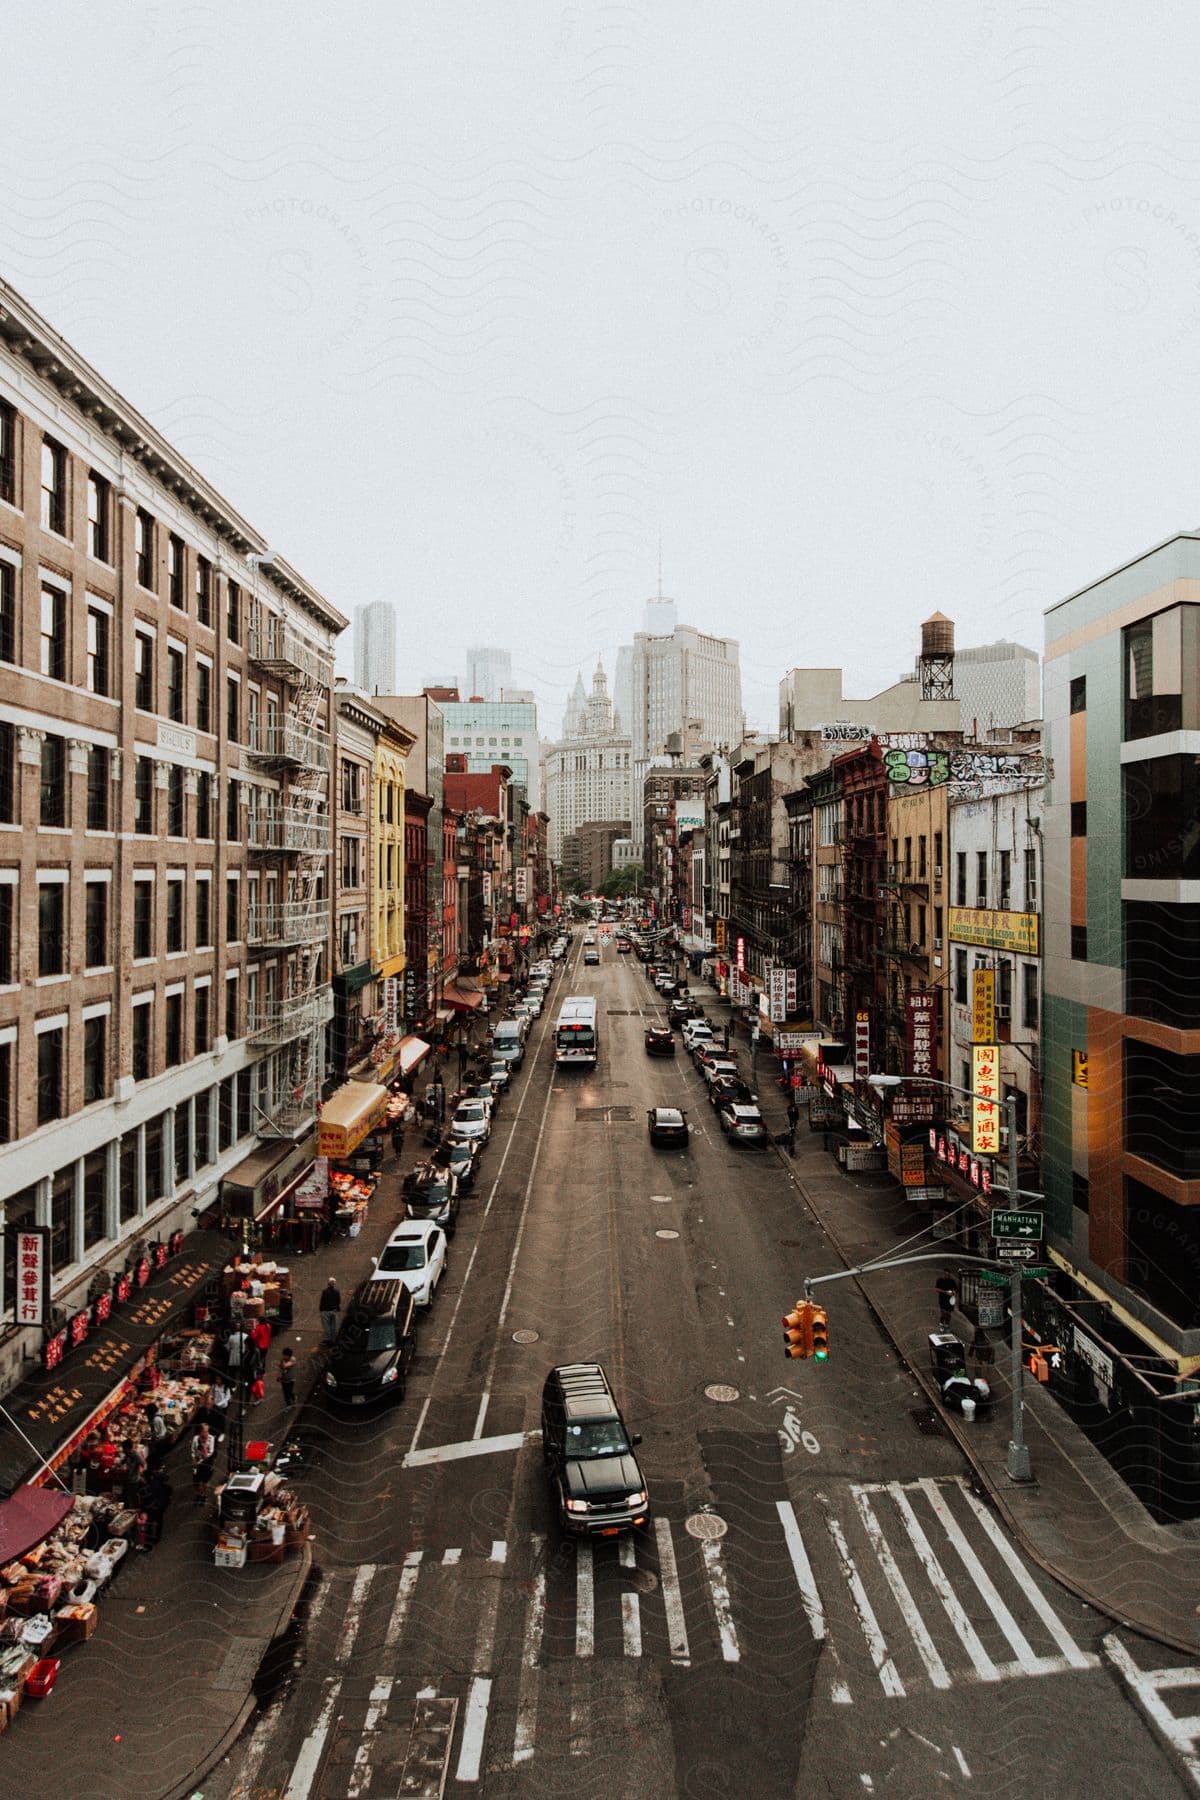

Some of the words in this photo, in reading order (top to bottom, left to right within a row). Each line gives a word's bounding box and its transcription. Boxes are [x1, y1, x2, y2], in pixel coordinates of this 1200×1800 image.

[856, 1012, 869, 1021] 66
[997, 1215, 1038, 1225] MANHATTAN
[1000, 1224, 1010, 1232] BR
